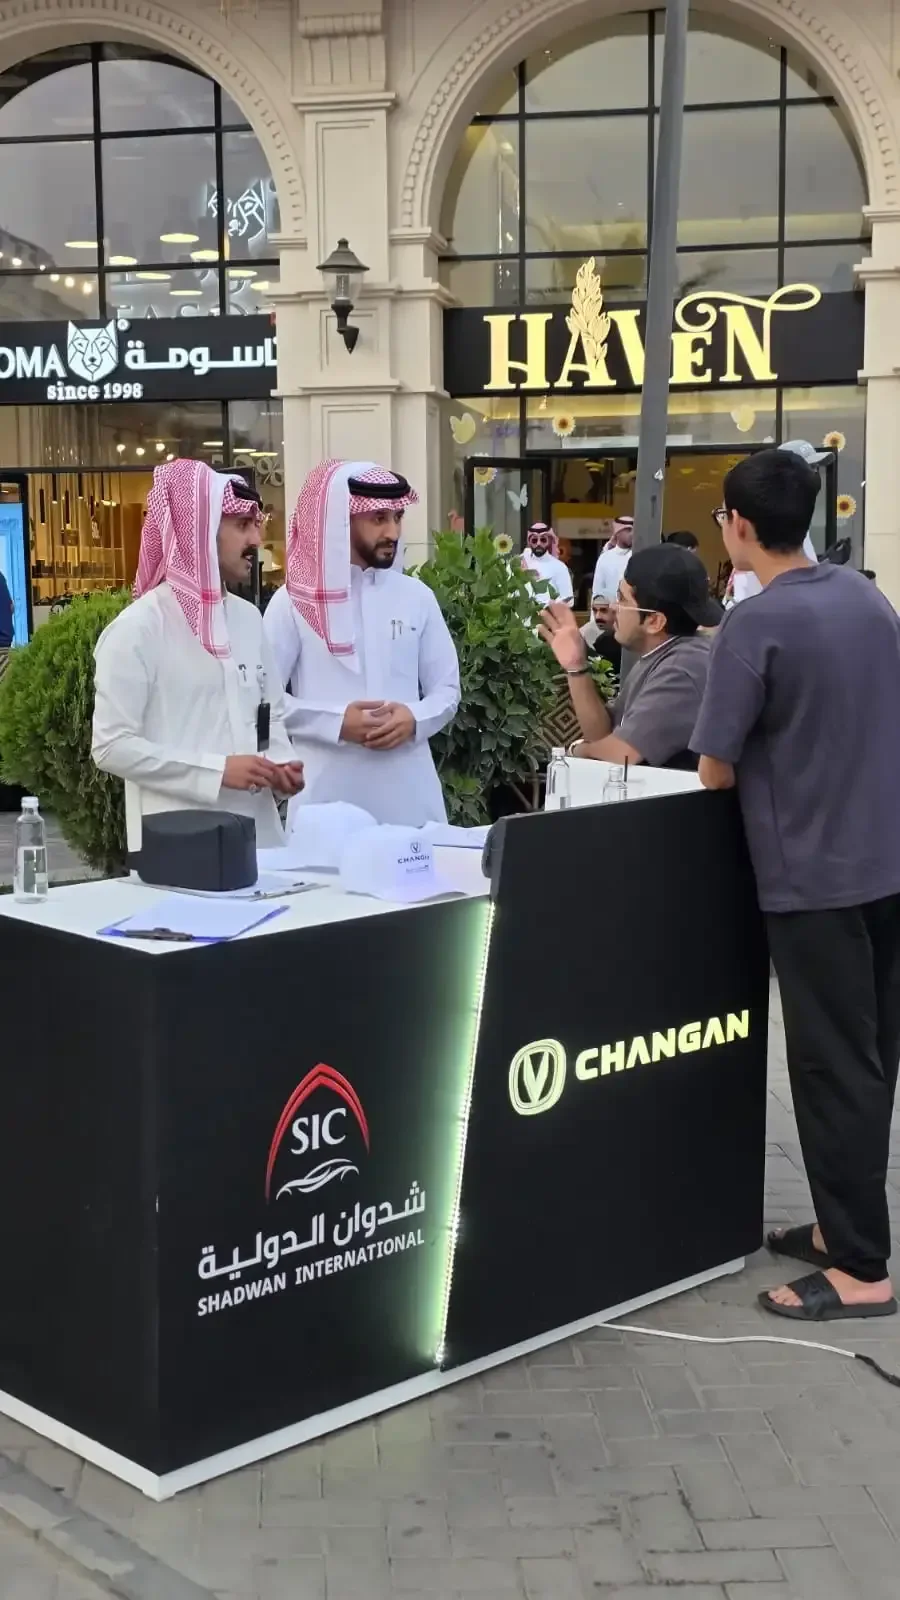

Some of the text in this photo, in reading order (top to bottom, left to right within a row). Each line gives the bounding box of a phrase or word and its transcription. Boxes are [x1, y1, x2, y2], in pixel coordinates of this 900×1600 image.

[0, 344, 67, 379] OMA
[124, 337, 278, 376] اسومة
[483, 283, 822, 390] HAVEN
[47, 381, 143, 401] since 1998
[575, 1009, 749, 1081] CHANGAN
[291, 1107, 347, 1155] SIC
[198, 1180, 426, 1281] شدوان الدولية
[198, 1229, 425, 1316] SHADWAN INTERNATIONAL
